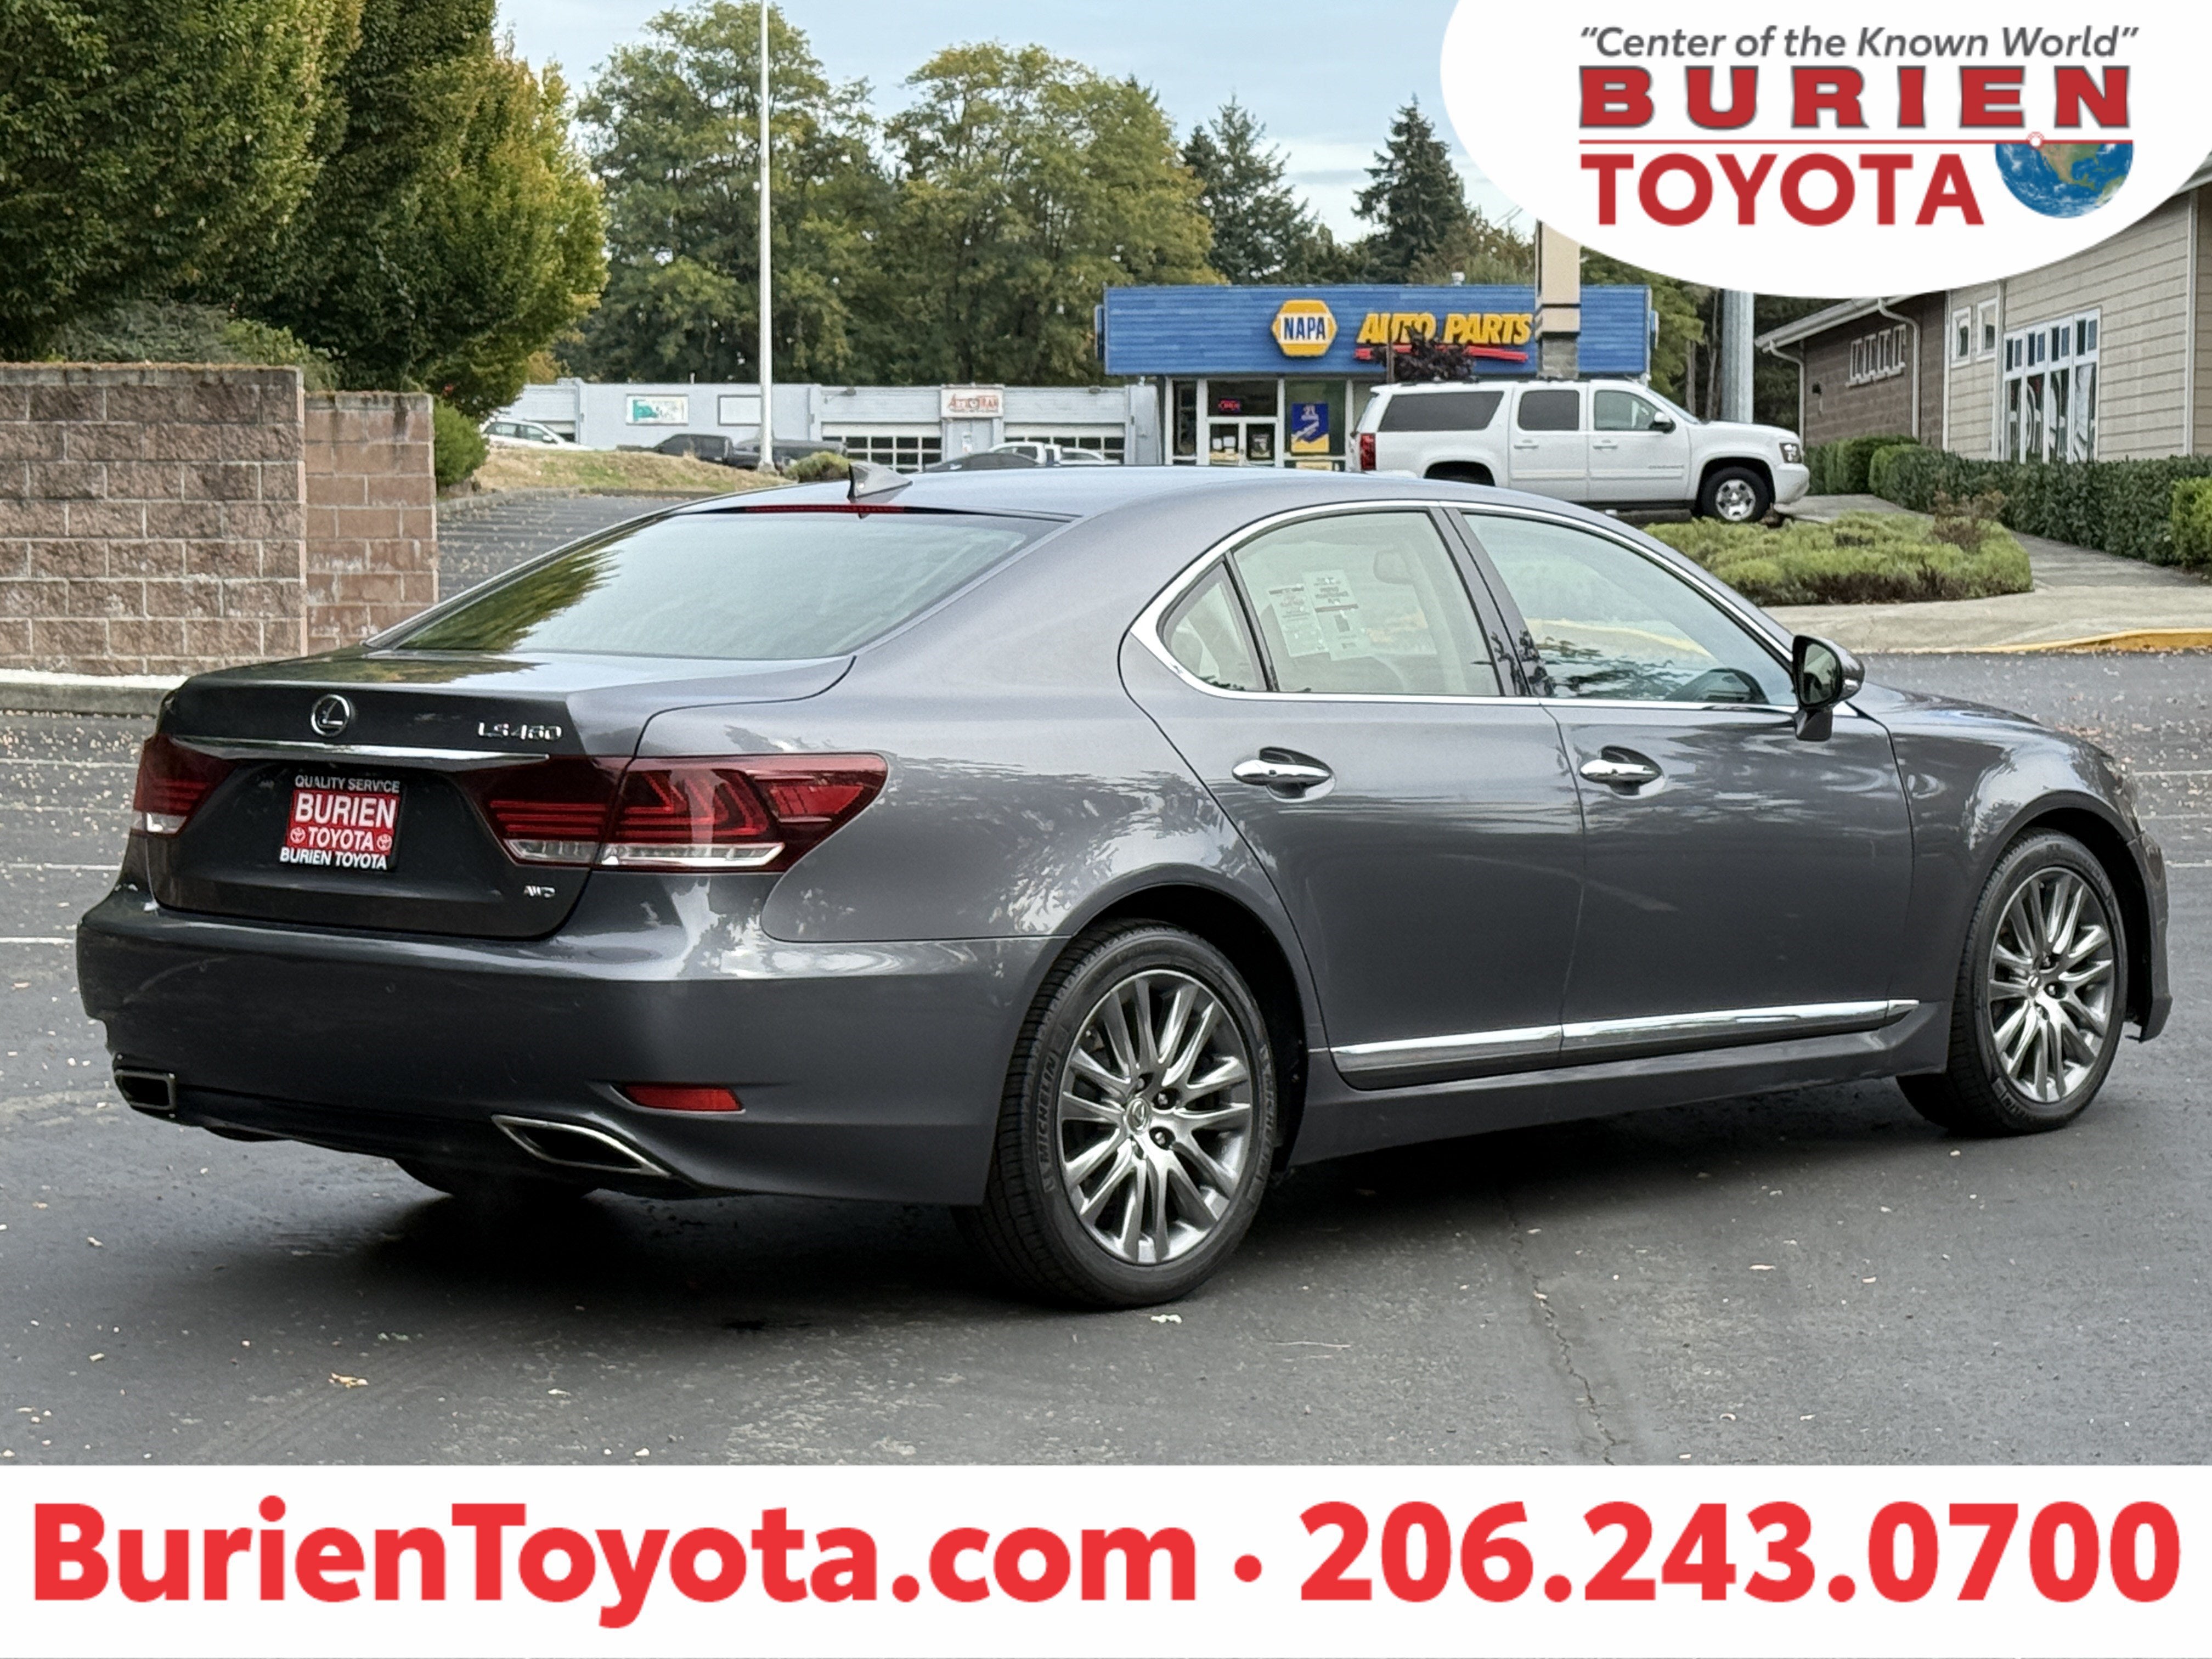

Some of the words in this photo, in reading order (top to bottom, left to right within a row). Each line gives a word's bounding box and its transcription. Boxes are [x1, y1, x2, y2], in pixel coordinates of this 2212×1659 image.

[1284, 317, 1326, 340] NAPA
[1357, 313, 1437, 344] AUTO
[1443, 313, 1533, 345] PARTS
[295, 775, 346, 790] QUALITY
[348, 778, 400, 794] SERVICE
[295, 792, 396, 829] BURIEN
[308, 826, 375, 851] TOYOTA
[279, 846, 332, 866] BURIEN
[335, 850, 387, 871] TOYOTA
